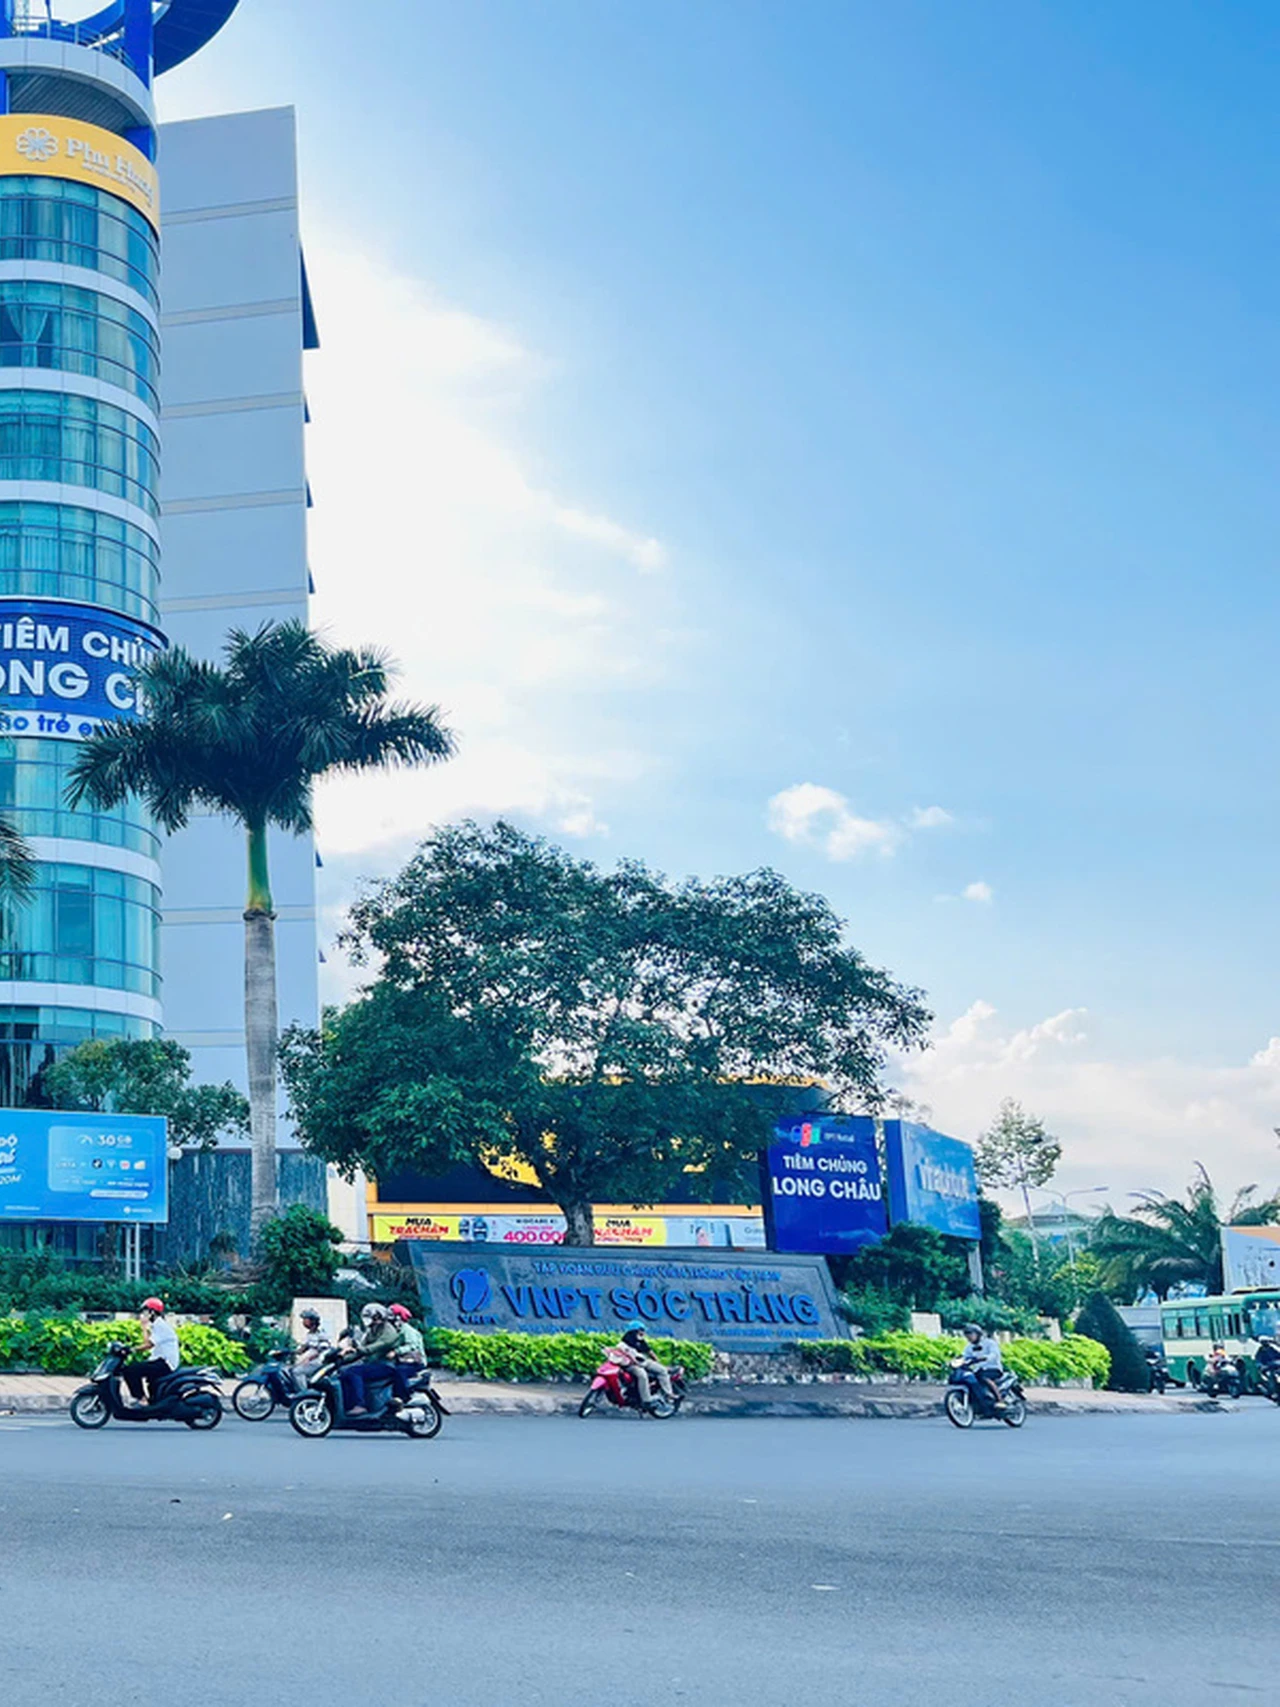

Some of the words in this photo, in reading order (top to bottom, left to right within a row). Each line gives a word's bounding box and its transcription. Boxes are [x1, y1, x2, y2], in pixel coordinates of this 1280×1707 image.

[37, 713, 71, 733] trẻ
[783, 1152, 815, 1170] TIÊM
[817, 1155, 868, 1174] CHỦNG
[773, 1177, 826, 1197] LONG
[829, 1178, 881, 1200] CHÂU
[502, 1284, 603, 1320] VNPT
[610, 1279, 692, 1321] SÓC
[692, 1281, 820, 1325] TRĂNG
